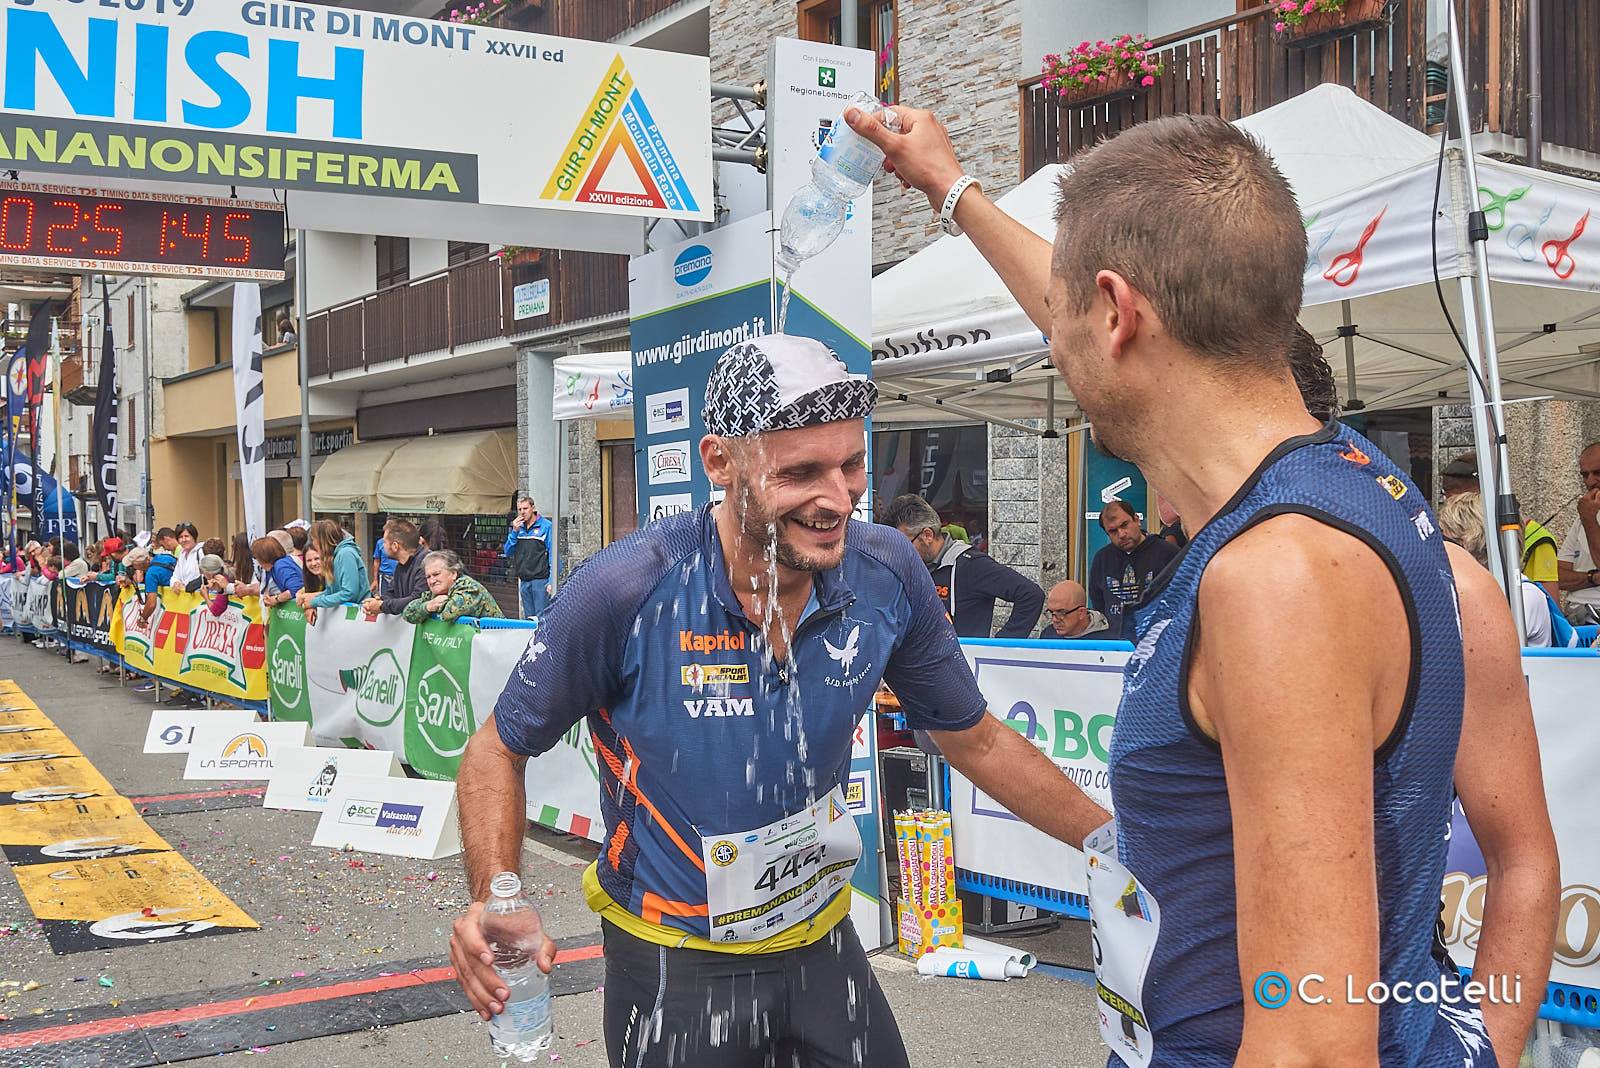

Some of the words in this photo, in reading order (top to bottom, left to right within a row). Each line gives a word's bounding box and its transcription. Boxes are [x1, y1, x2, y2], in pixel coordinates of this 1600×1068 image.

[241, 1, 315, 32] GIIR
[326, 10, 361, 38] DI
[373, 18, 476, 51] MONT
[485, 39, 537, 61] XXVII
[542, 47, 564, 63] ed
[4, 7, 364, 140] NISH
[556, 151, 586, 192] GIIR
[577, 128, 597, 151] DI
[590, 71, 626, 129] MONT
[624, 111, 659, 174] Mountain
[656, 173, 677, 206] Race
[647, 123, 681, 181] Premana
[21, 182, 40, 191] DATA
[42, 184, 76, 194] SERVICE
[101, 189, 130, 198] TIMING
[132, 191, 150, 200] DATA
[151, 193, 185, 202] SERVICE
[206, 197, 234, 207] TIMING
[235, 198, 253, 208] DATA
[254, 200, 284, 211] SERVICE
[588, 192, 613, 204] XXVII
[615, 194, 654, 207] edizione
[21, 256, 41, 265] DATA
[42, 257, 77, 267] SERVICE
[101, 261, 130, 270] TIMING
[131, 262, 150, 271] DATA
[151, 263, 185, 273] SERVICE
[206, 267, 234, 276] TIMING
[235, 268, 253, 277] DATA
[254, 269, 285, 279] SERVICE
[674, 256, 712, 276] premana
[635, 316, 766, 367] www.giirdimont.it
[657, 454, 681, 469] CIRESA
[193, 608, 238, 659] CIRESA
[442, 635, 463, 648] ITALY
[679, 629, 745, 655] Kapriol
[271, 648, 303, 690] Sanelli
[720, 667, 746, 675] SPORT
[683, 697, 755, 718] VAM
[200, 759, 216, 769] LA
[357, 806, 378, 815] BCC
[381, 809, 418, 822] Valsassina
[1018, 906, 1027, 920] 7
